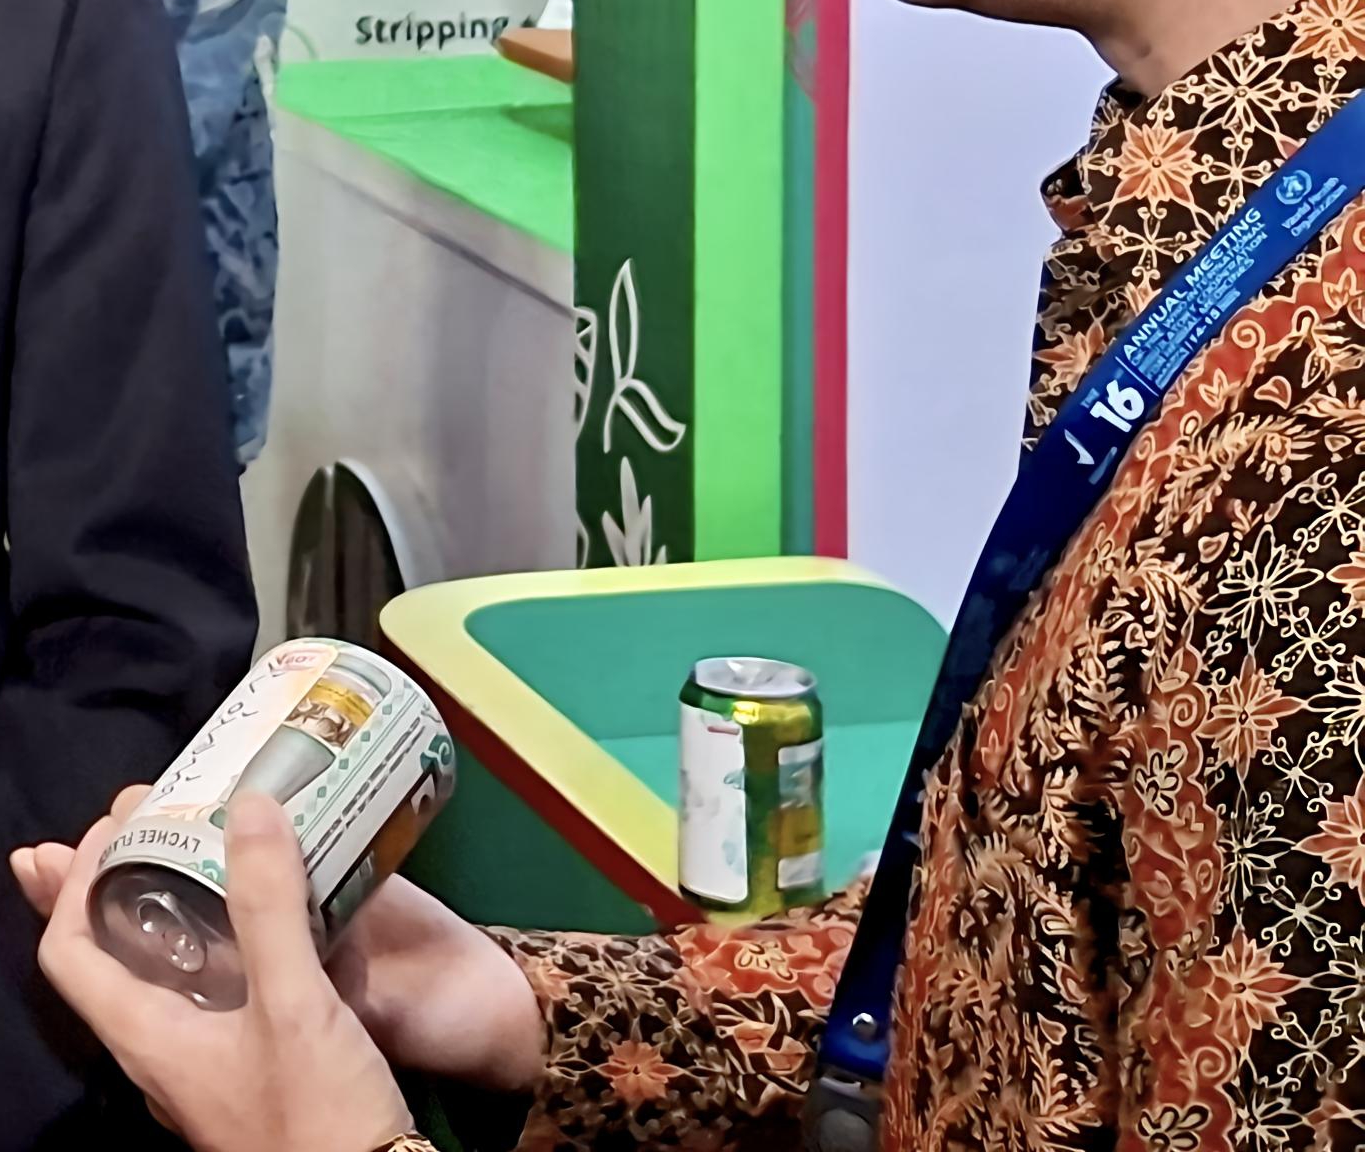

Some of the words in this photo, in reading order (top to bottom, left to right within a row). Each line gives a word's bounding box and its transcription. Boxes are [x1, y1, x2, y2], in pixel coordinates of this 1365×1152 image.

[1123, 290, 1188, 360] ANNUAL
[1184, 206, 1260, 287] MEETING
[1089, 379, 1145, 433] 16
[135, 829, 201, 853] LYCHEE
